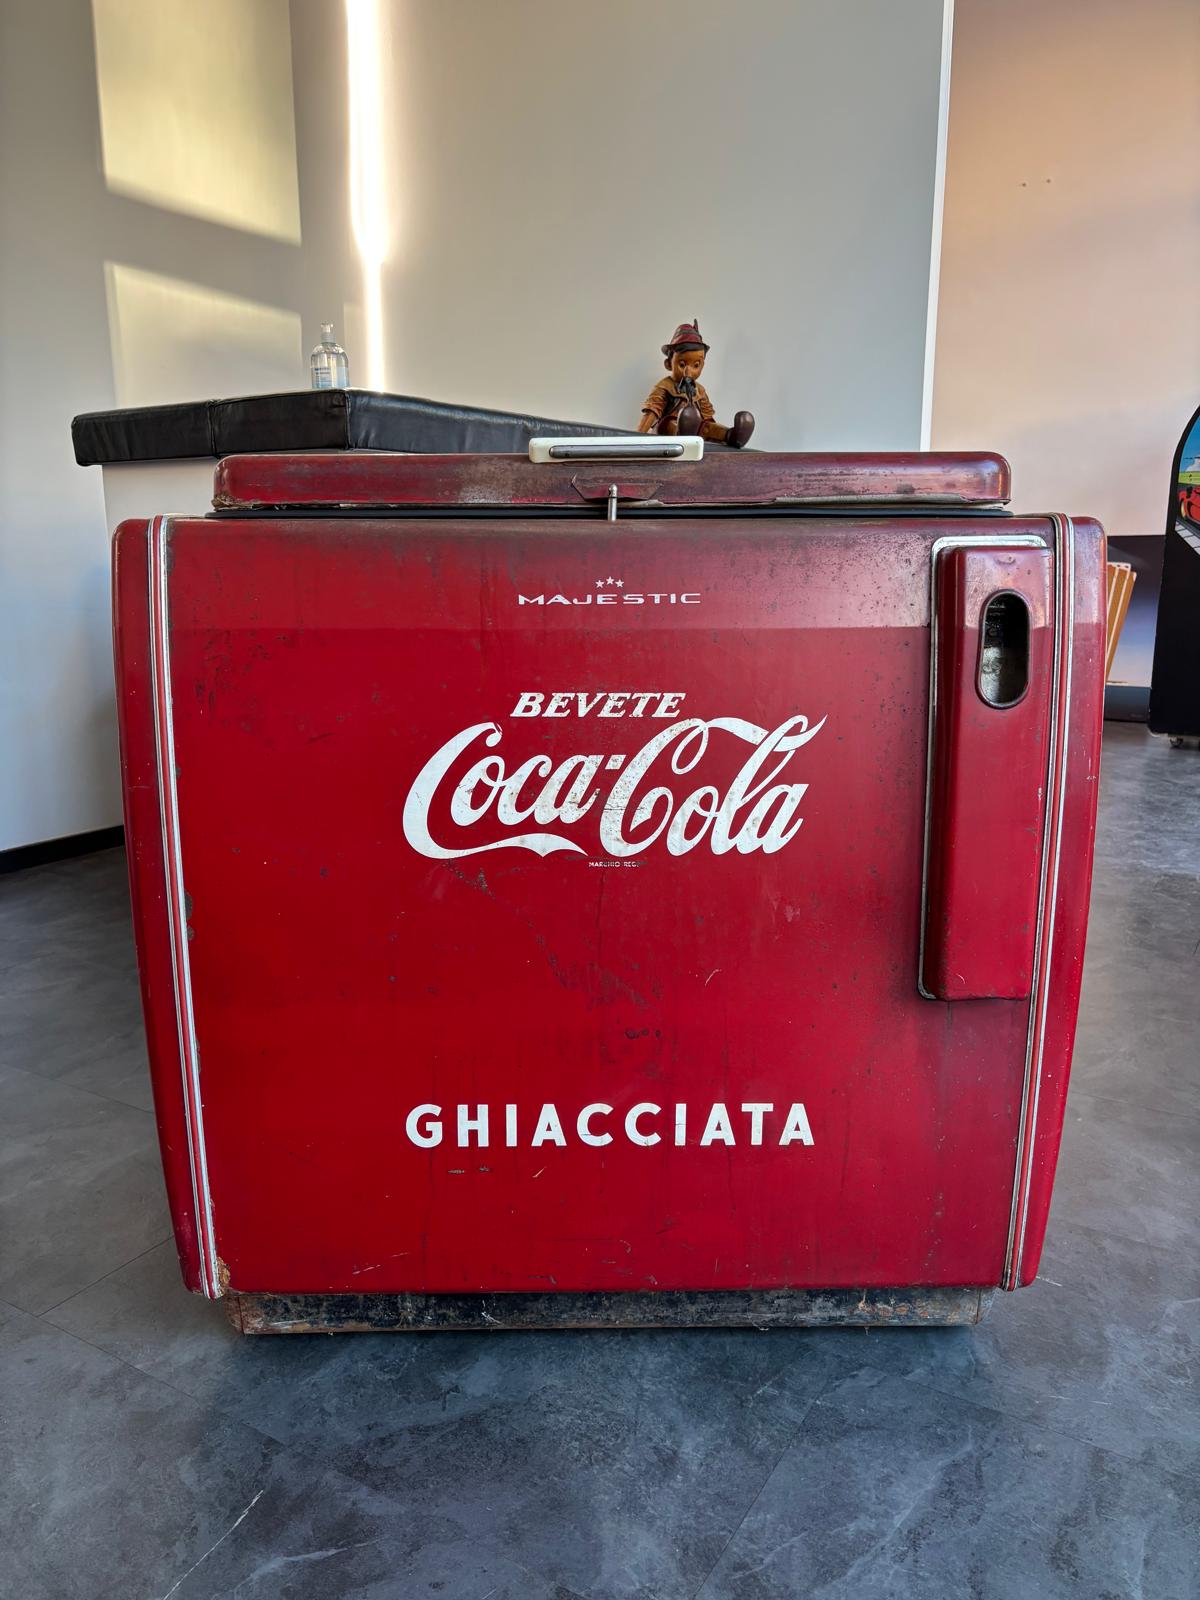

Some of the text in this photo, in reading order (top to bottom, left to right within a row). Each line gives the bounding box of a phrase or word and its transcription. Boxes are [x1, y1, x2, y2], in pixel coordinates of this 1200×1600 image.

[518, 593, 702, 606] MAJESTIC
[510, 692, 686, 718] BEVETE
[403, 714, 827, 859] Coca-Cola
[406, 1103, 814, 1148] GHIACCIATA
